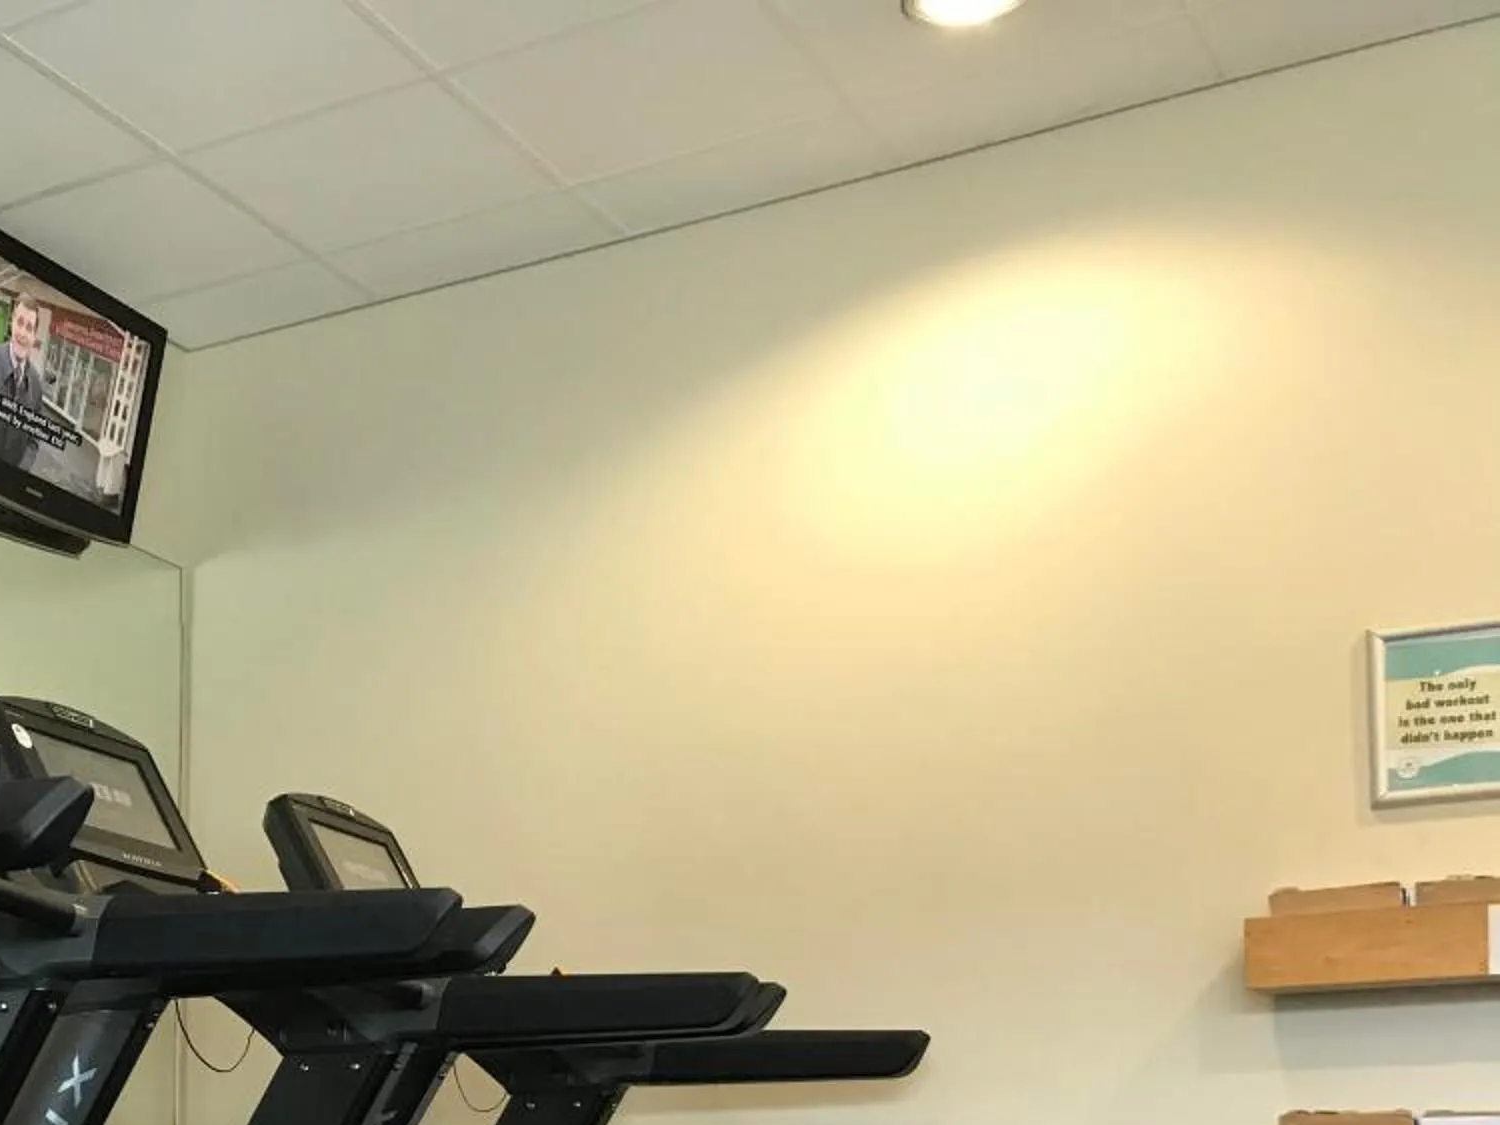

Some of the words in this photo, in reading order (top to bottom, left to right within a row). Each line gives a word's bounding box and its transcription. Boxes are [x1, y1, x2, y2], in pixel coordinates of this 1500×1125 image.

[1420, 681, 1444, 692] The
[1447, 678, 1476, 692] only
[1406, 697, 1430, 710] bad
[1434, 694, 1489, 708] workout
[1398, 716, 1410, 727] is
[1414, 716, 1435, 727] the
[1440, 715, 1464, 724] one
[1469, 710, 1496, 721] that
[1400, 731, 1439, 744] didn't
[1443, 730, 1493, 742] happen
